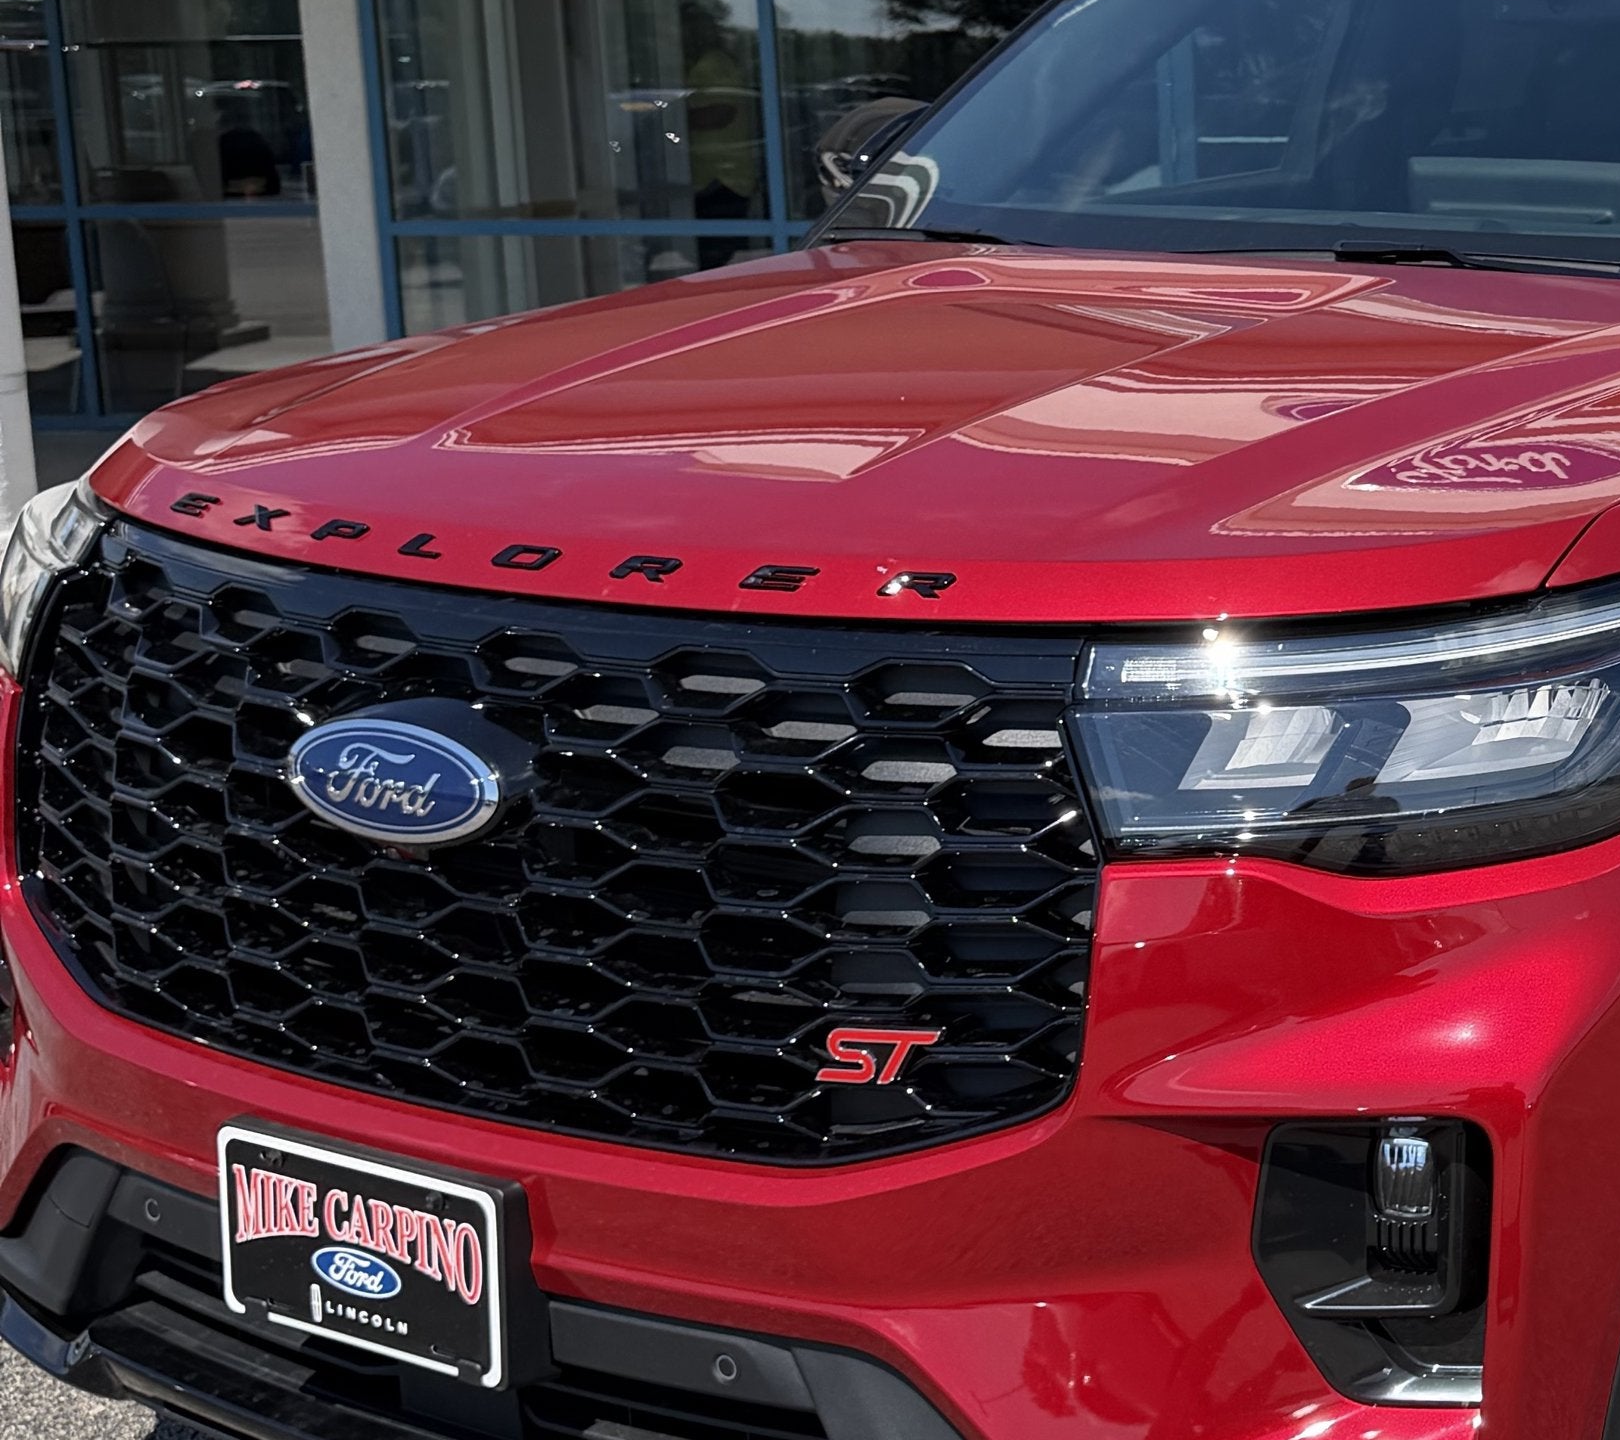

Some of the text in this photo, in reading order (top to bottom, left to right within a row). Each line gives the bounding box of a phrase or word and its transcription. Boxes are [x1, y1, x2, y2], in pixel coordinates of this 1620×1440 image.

[169, 491, 957, 599] EXPLORER
[326, 742, 441, 817] Ford
[814, 1027, 941, 1085] ST
[232, 1162, 484, 1306] MIKE CARPINO
[328, 1252, 384, 1293] Ford
[324, 1300, 409, 1336] LINCOLN
